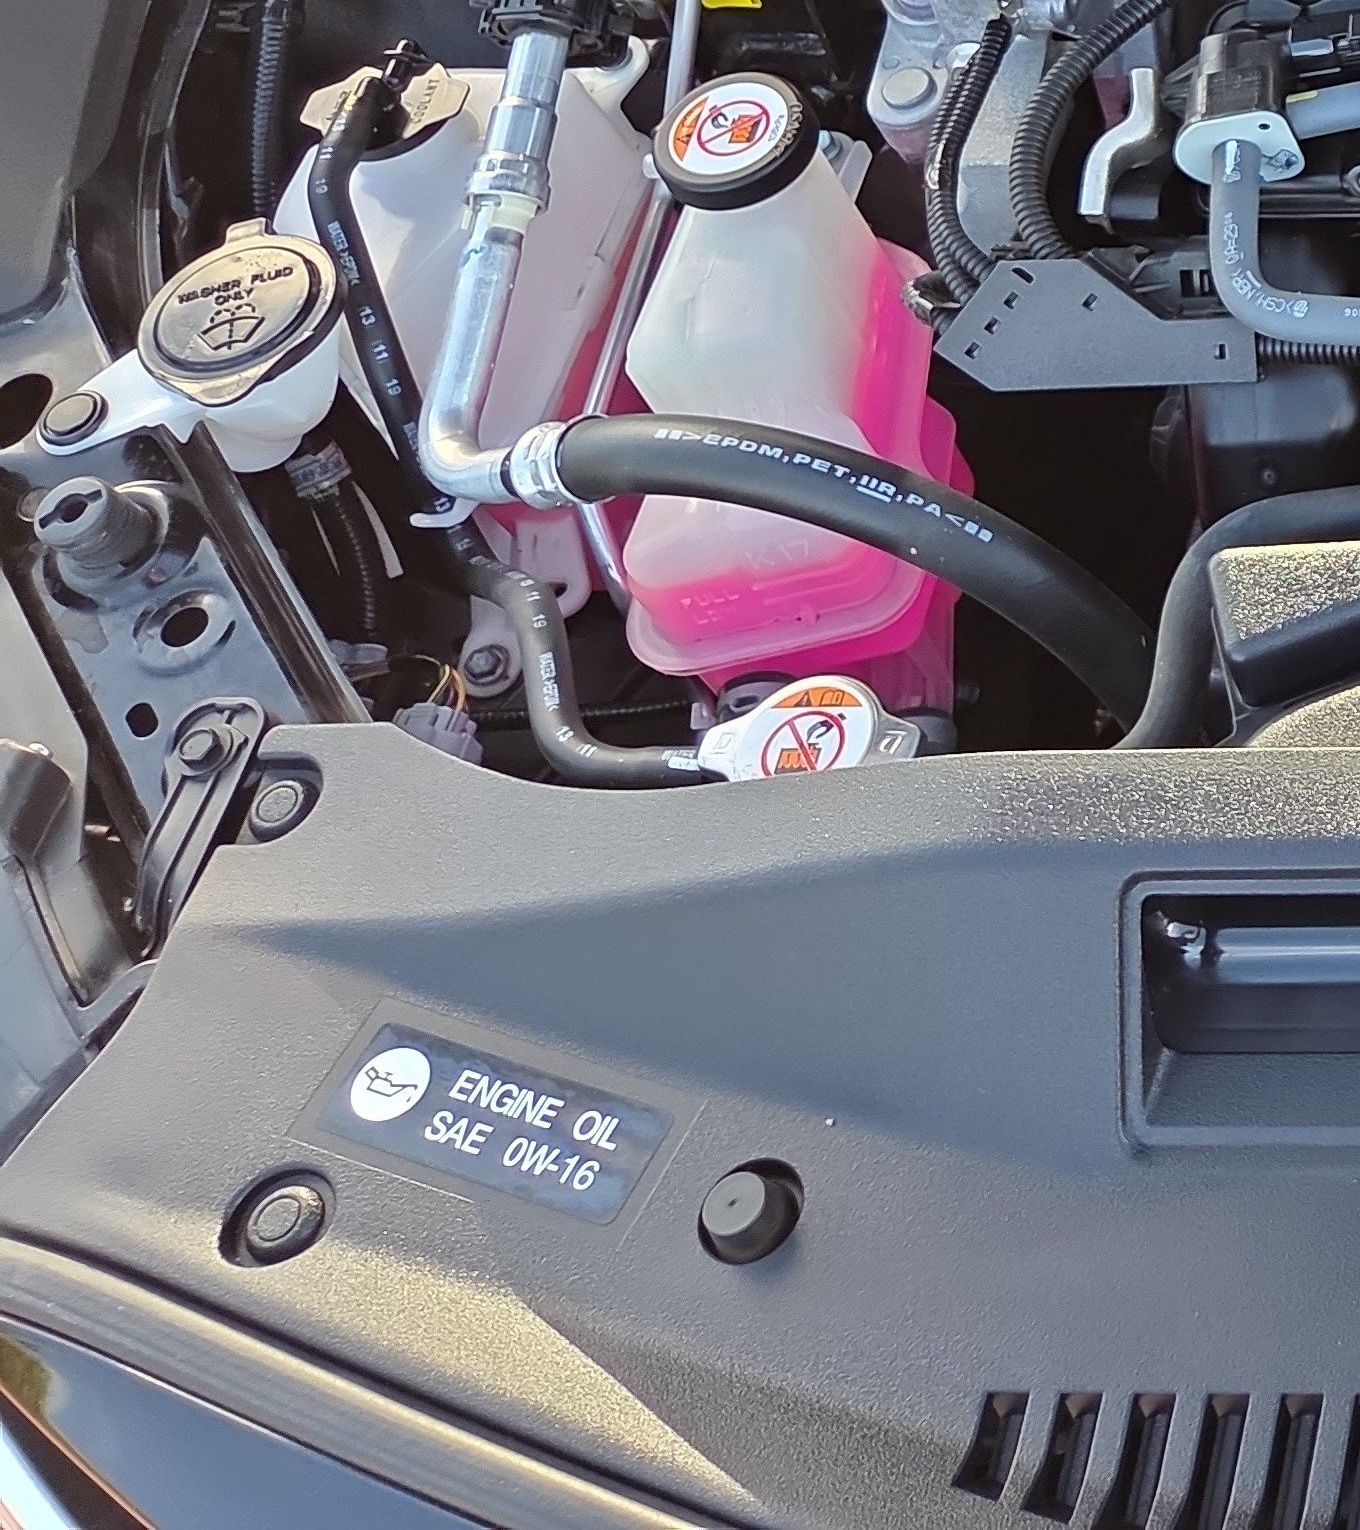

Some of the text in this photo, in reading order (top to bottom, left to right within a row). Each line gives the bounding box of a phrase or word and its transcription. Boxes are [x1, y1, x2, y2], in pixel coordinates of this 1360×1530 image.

[409, 79, 441, 124] COOLANT
[177, 266, 294, 305] WASHER FLUID
[214, 287, 255, 306] ONLY
[448, 1069, 620, 1151] ENGINE OIL
[424, 1109, 601, 1191] SAE 0W-16
